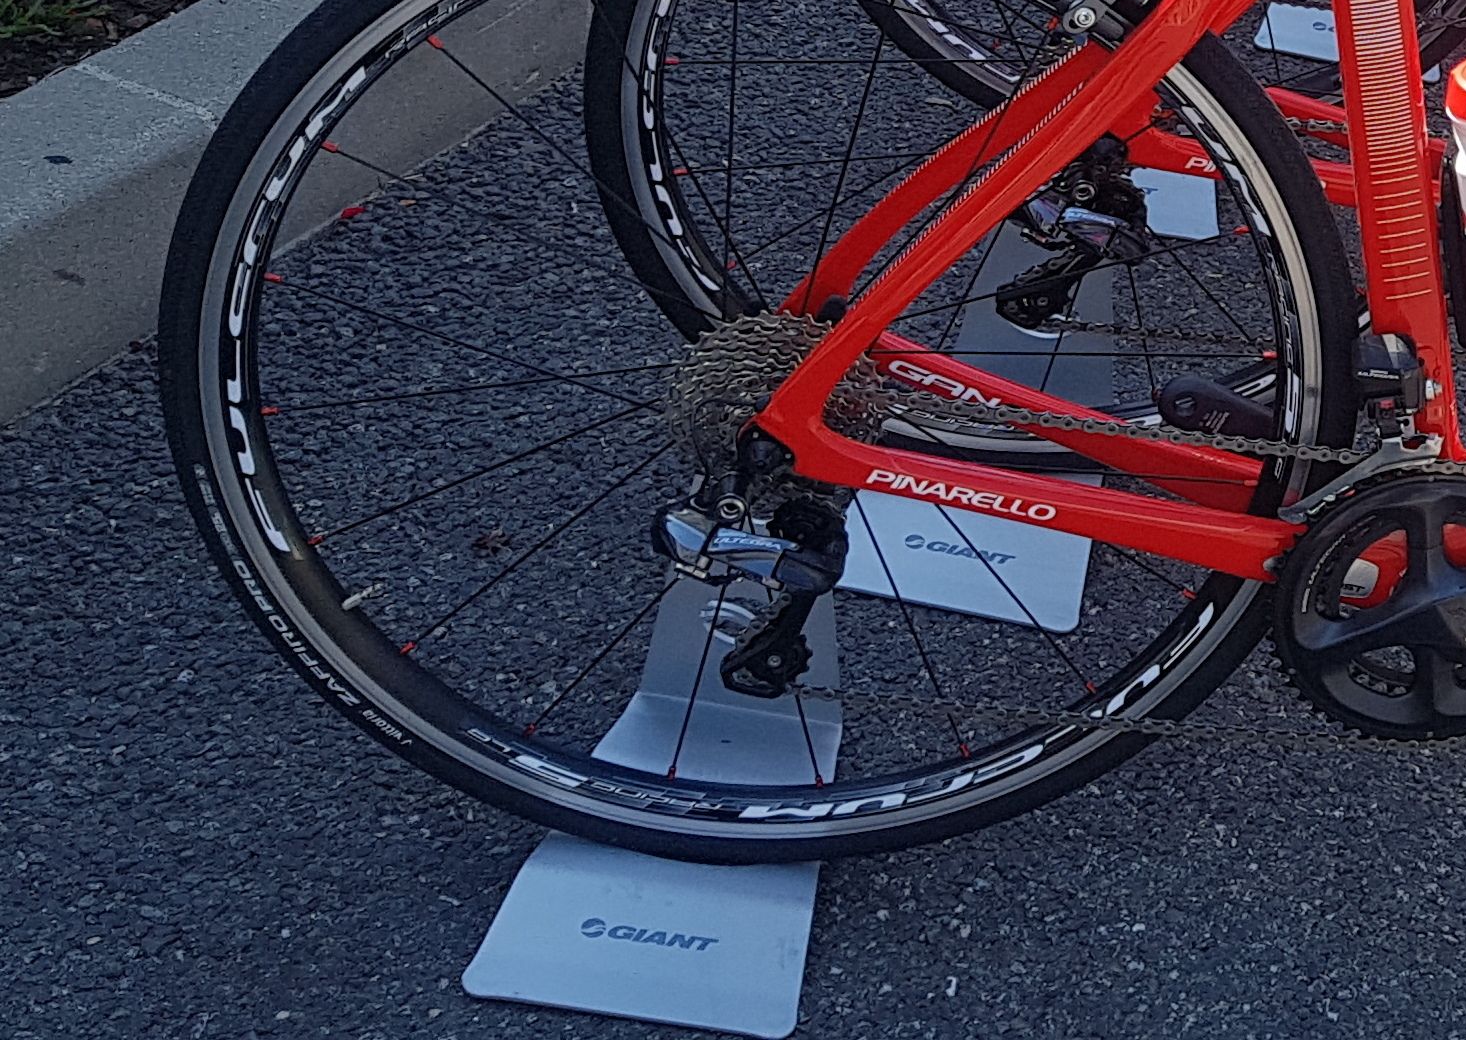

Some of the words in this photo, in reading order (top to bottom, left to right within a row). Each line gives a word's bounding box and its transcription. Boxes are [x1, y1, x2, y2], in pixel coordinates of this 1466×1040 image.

[866, 468, 1056, 521] PINARELLO
[713, 534, 784, 551] ULTEGRA
[926, 540, 1016, 565] GIANT
[233, 560, 274, 612] PRO
[268, 614, 361, 707] ZAFFIRO
[607, 924, 721, 953] GIANT
